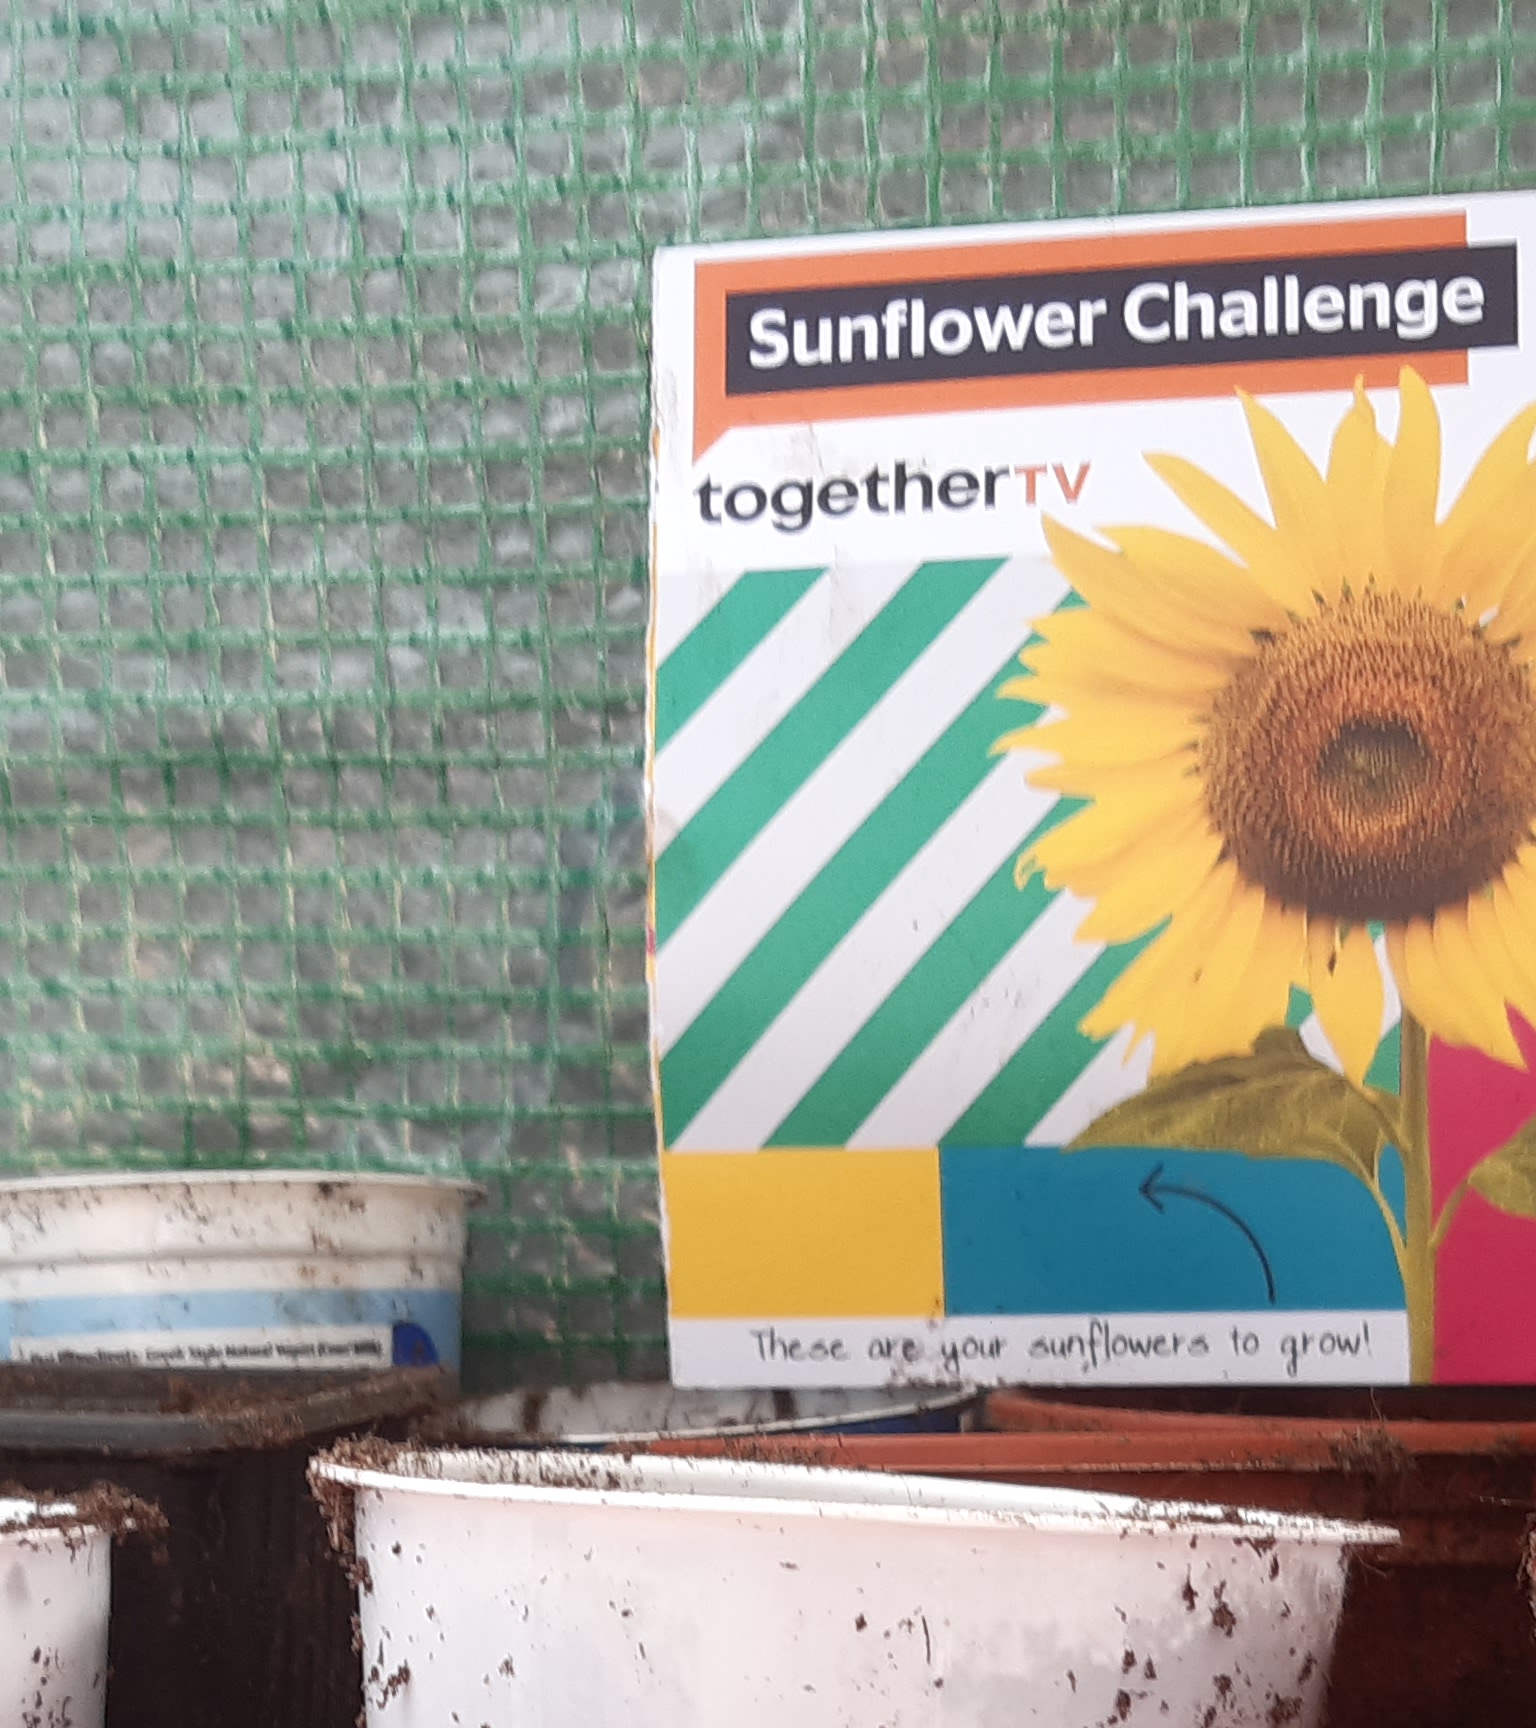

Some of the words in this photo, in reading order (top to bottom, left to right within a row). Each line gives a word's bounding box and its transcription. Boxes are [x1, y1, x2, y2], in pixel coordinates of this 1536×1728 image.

[748, 294, 1108, 370] Sunflower
[1122, 273, 1486, 342] Challenge
[695, 461, 1091, 532] togetherTV
[751, 1325, 848, 1362] These
[867, 1336, 921, 1363] are
[941, 1336, 1007, 1376] your
[1027, 1318, 1211, 1373] sunflowers
[1230, 1326, 1262, 1358] to
[1280, 1320, 1374, 1377] grow!
